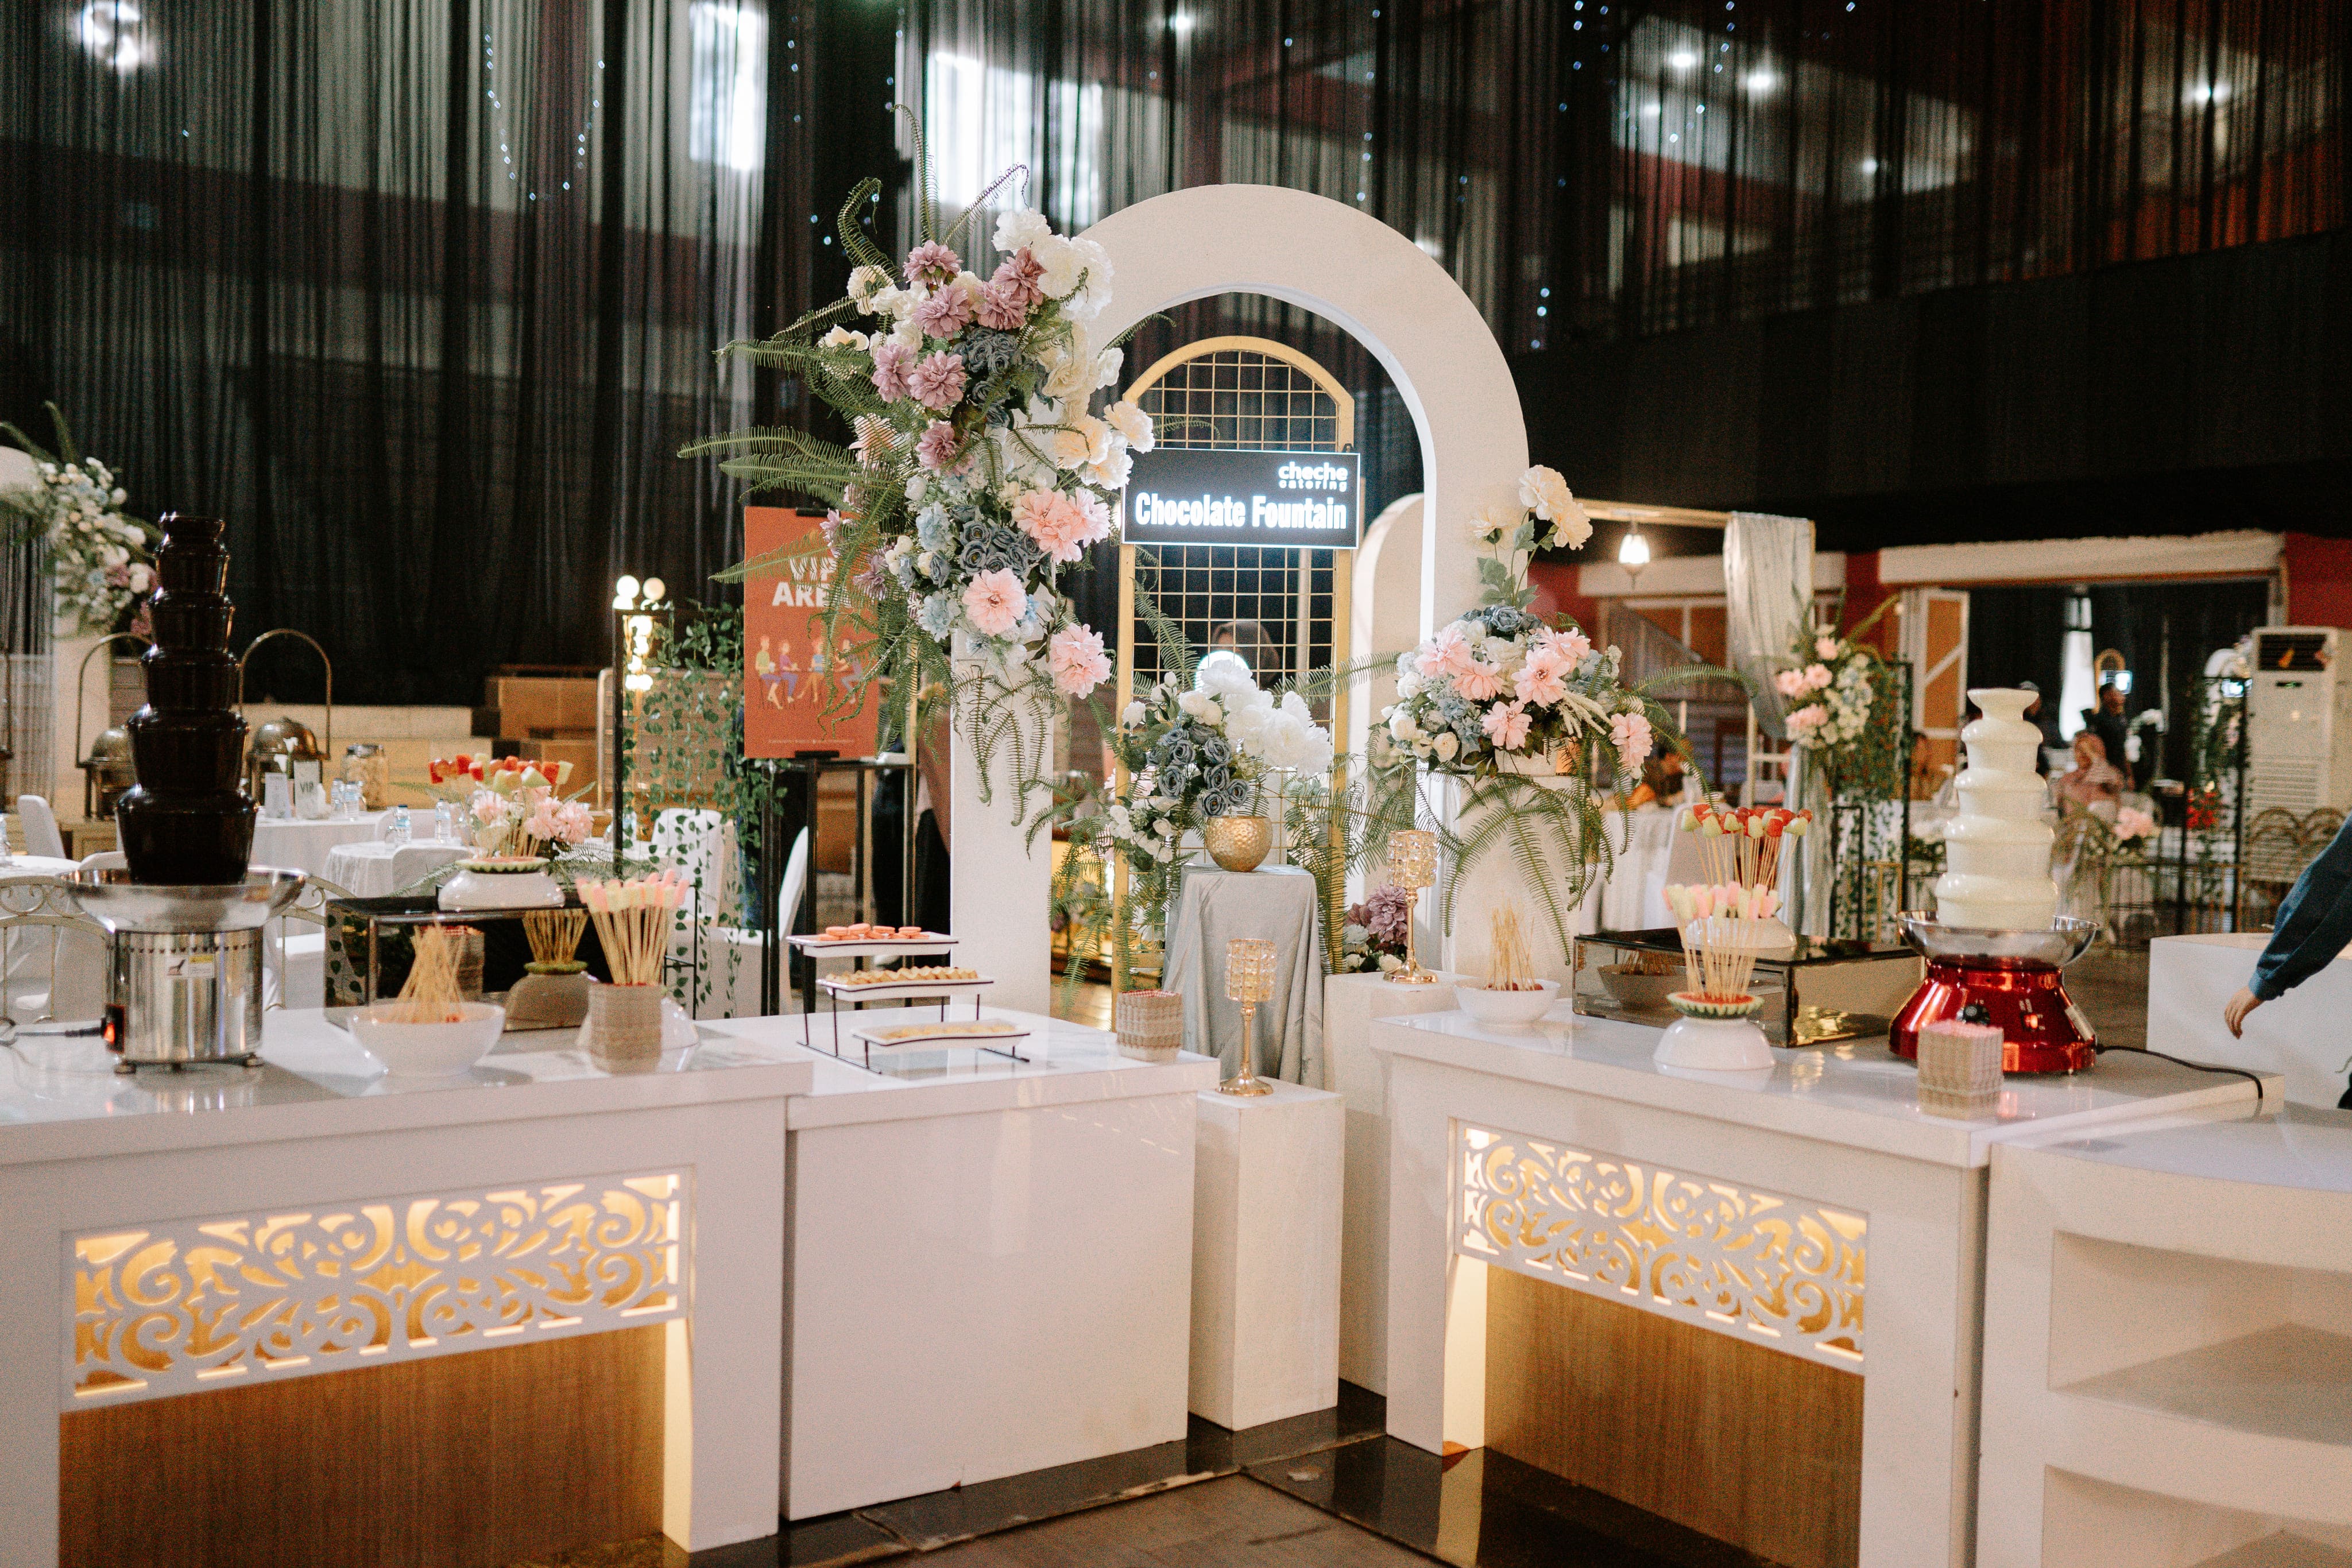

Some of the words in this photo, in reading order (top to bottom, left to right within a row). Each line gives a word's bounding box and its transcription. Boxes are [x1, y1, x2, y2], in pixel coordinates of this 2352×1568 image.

[1278, 461, 1348, 481] cheche
[1279, 479, 1347, 493] catering
[1135, 492, 1246, 528] Chocolate
[1251, 495, 1347, 529] Fountain
[299, 781, 314, 793] VIP
